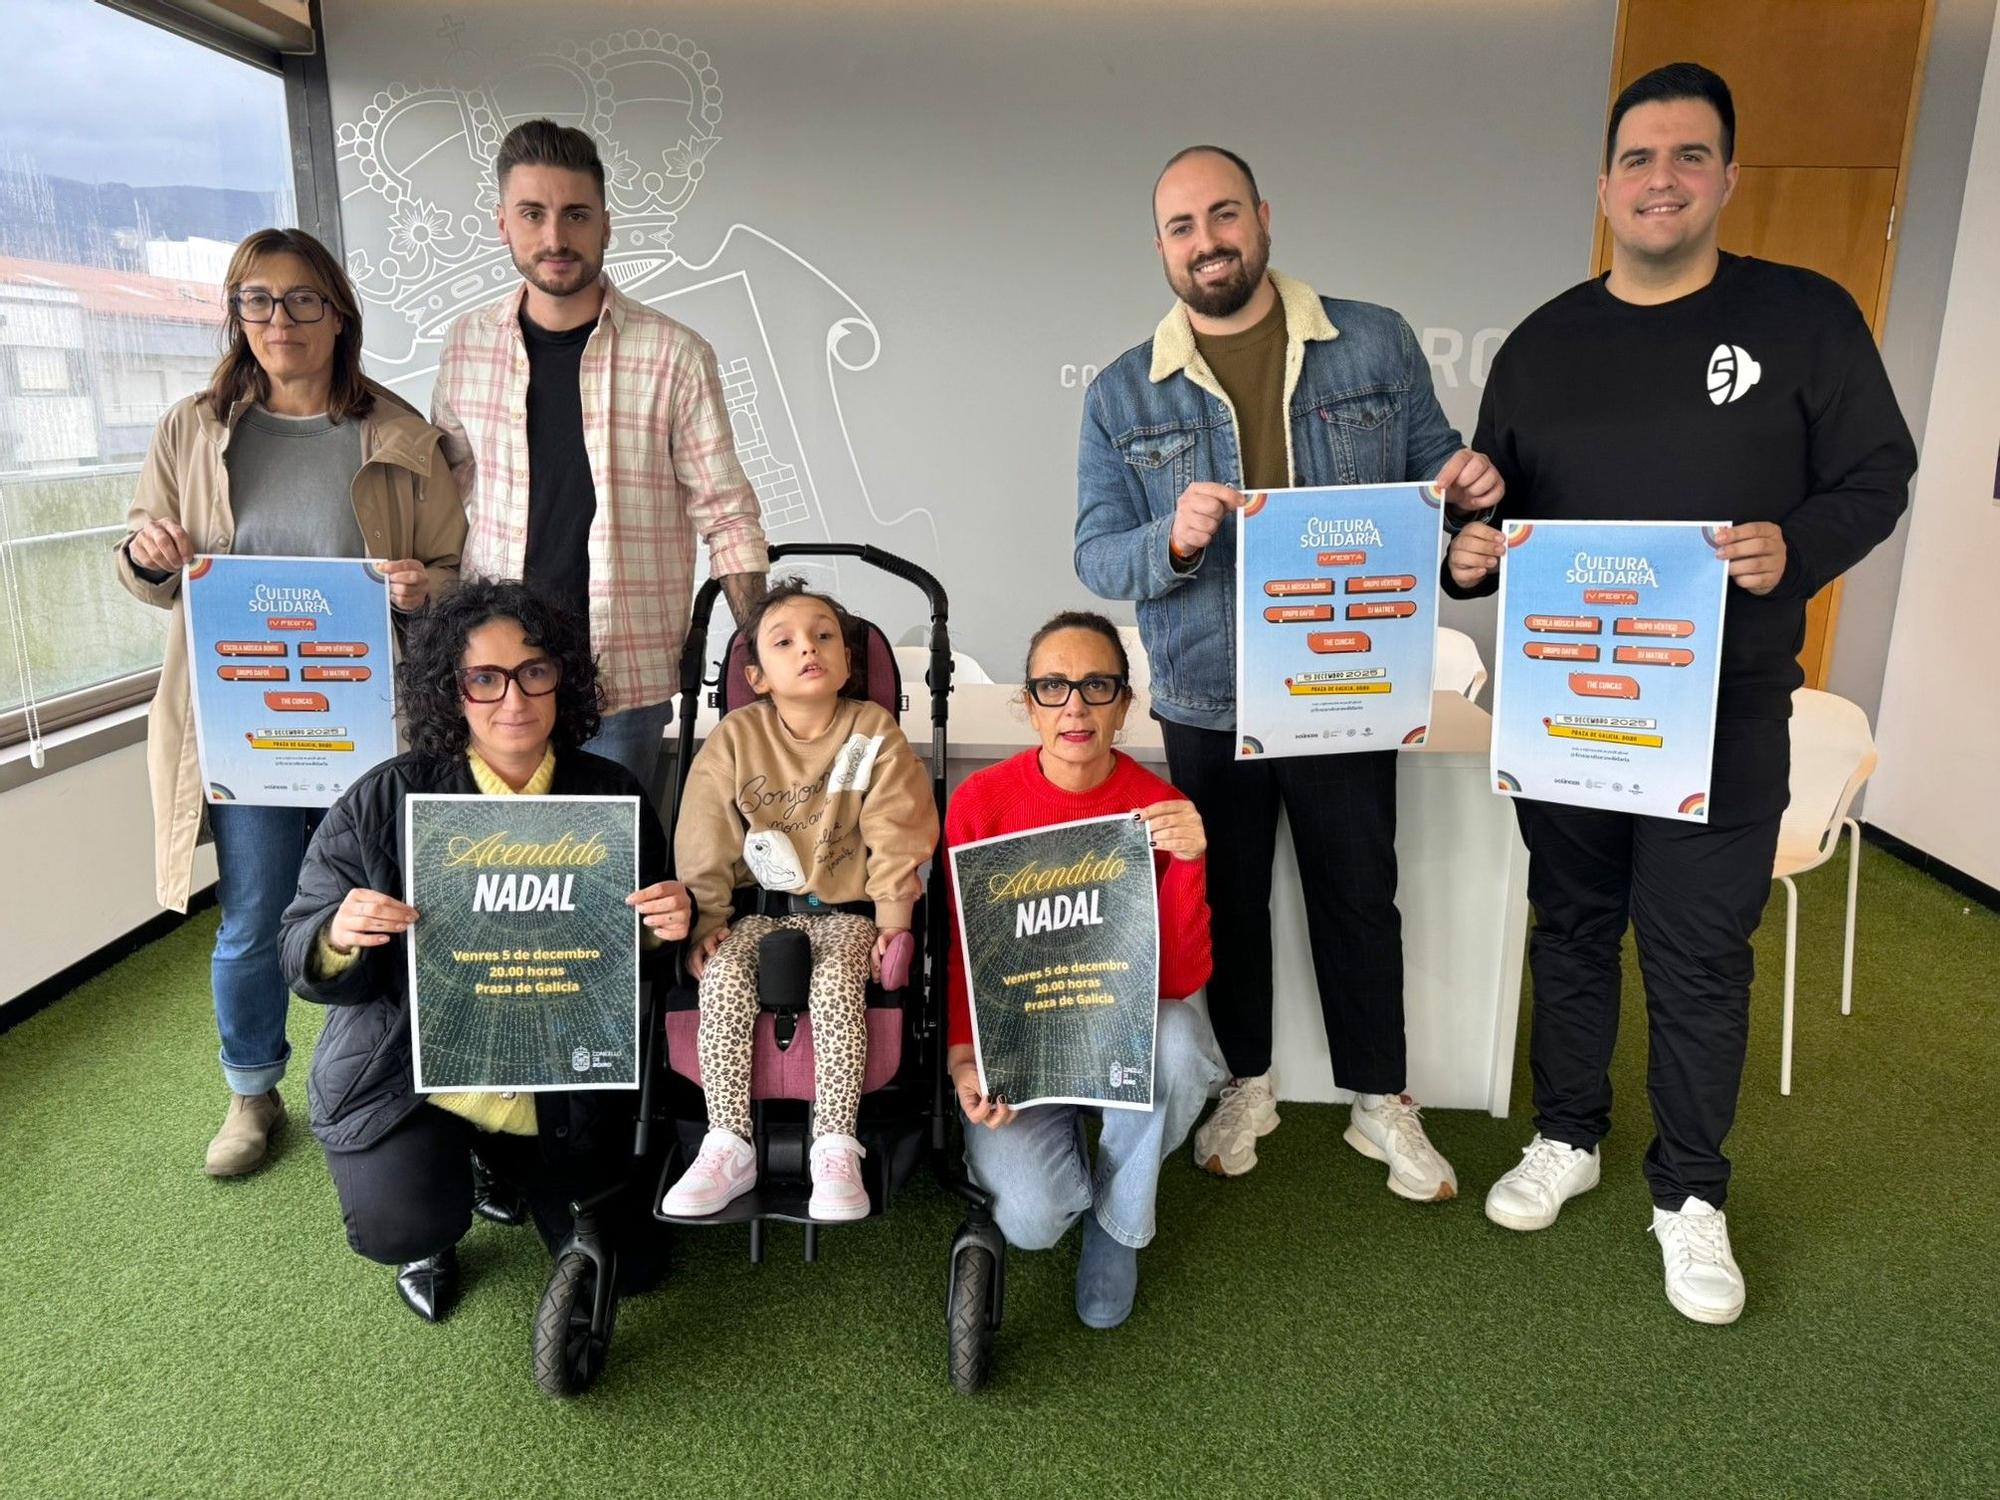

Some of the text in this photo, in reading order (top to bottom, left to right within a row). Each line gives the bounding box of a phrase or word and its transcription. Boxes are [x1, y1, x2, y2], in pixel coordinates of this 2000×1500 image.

[1307, 517, 1374, 536] CULTURA
[1300, 528, 1384, 548] SOLIDARIA
[1574, 552, 1648, 572] CULTURA
[1566, 568, 1659, 588] SOLIDARIA
[256, 584, 322, 602] CULTURA
[249, 598, 332, 616] SOLIDARIA
[1586, 681, 1598, 689] THE
[280, 697, 291, 705] THE
[1574, 717, 1608, 725] DECEMBRO
[1610, 718, 1647, 727] 2025
[1571, 729, 1588, 737] PRAZA
[442, 831, 608, 868] Acendido
[986, 846, 1126, 904] Acendido
[472, 874, 576, 912] NADAL
[1015, 889, 1103, 938] NADAL
[453, 948, 600, 961] Venres 5 de decembro
[489, 966, 565, 977] 20.00 horas
[1002, 960, 1129, 986] Venres 5 de decembro
[475, 981, 580, 994] Praza de Galicia
[1035, 978, 1100, 994] 20.00 horas
[1024, 993, 1115, 1012] Praza de Galicia
